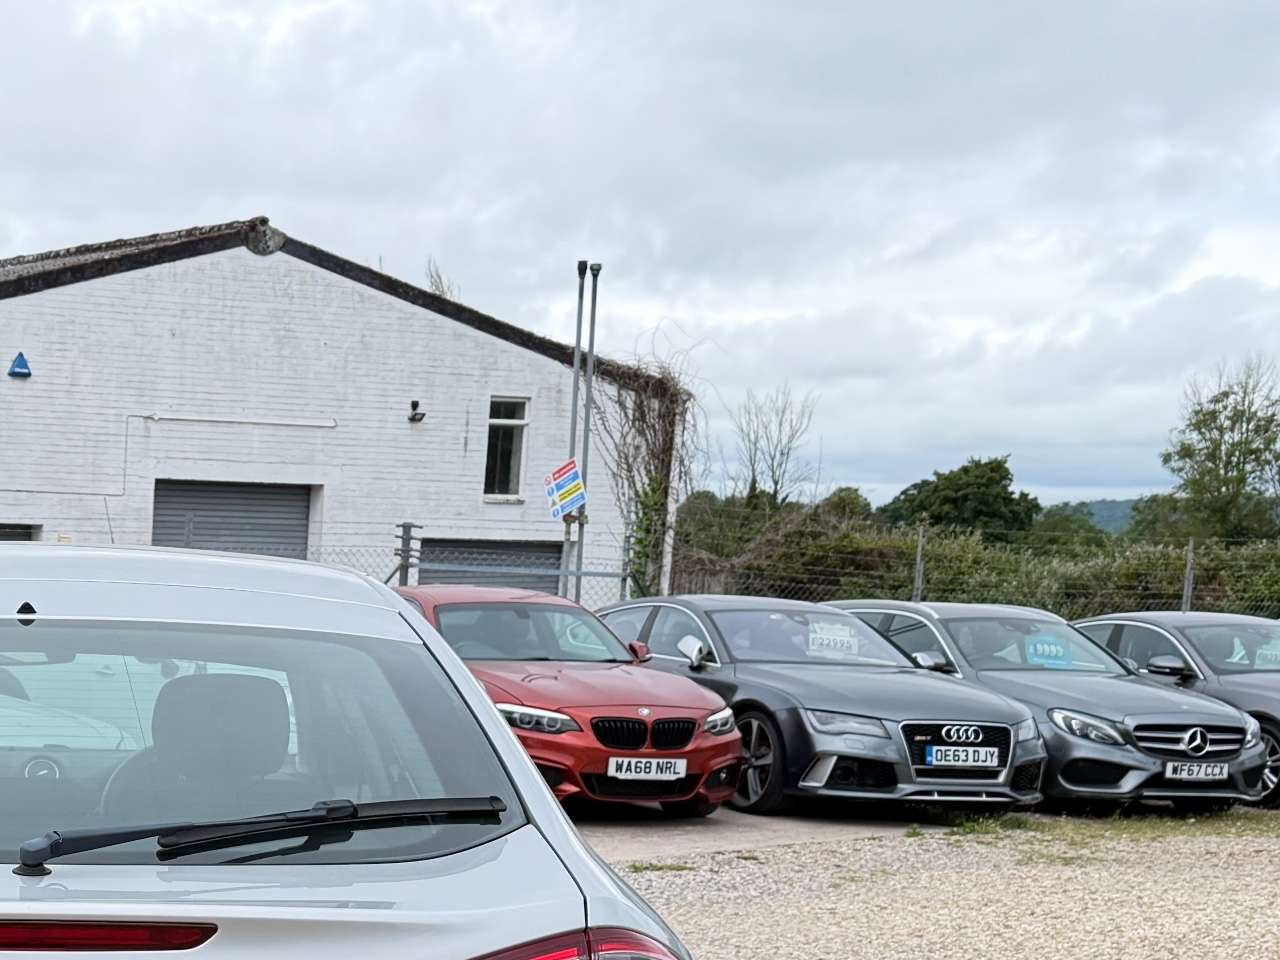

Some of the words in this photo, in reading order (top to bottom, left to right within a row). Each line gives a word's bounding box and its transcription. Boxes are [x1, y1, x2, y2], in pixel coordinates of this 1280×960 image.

[935, 749, 969, 762] OE63
[973, 750, 996, 763] DJY
[615, 760, 652, 774] WA68
[655, 761, 681, 775] NRL
[1172, 763, 1202, 777] WF67
[1204, 764, 1225, 777] CCX
